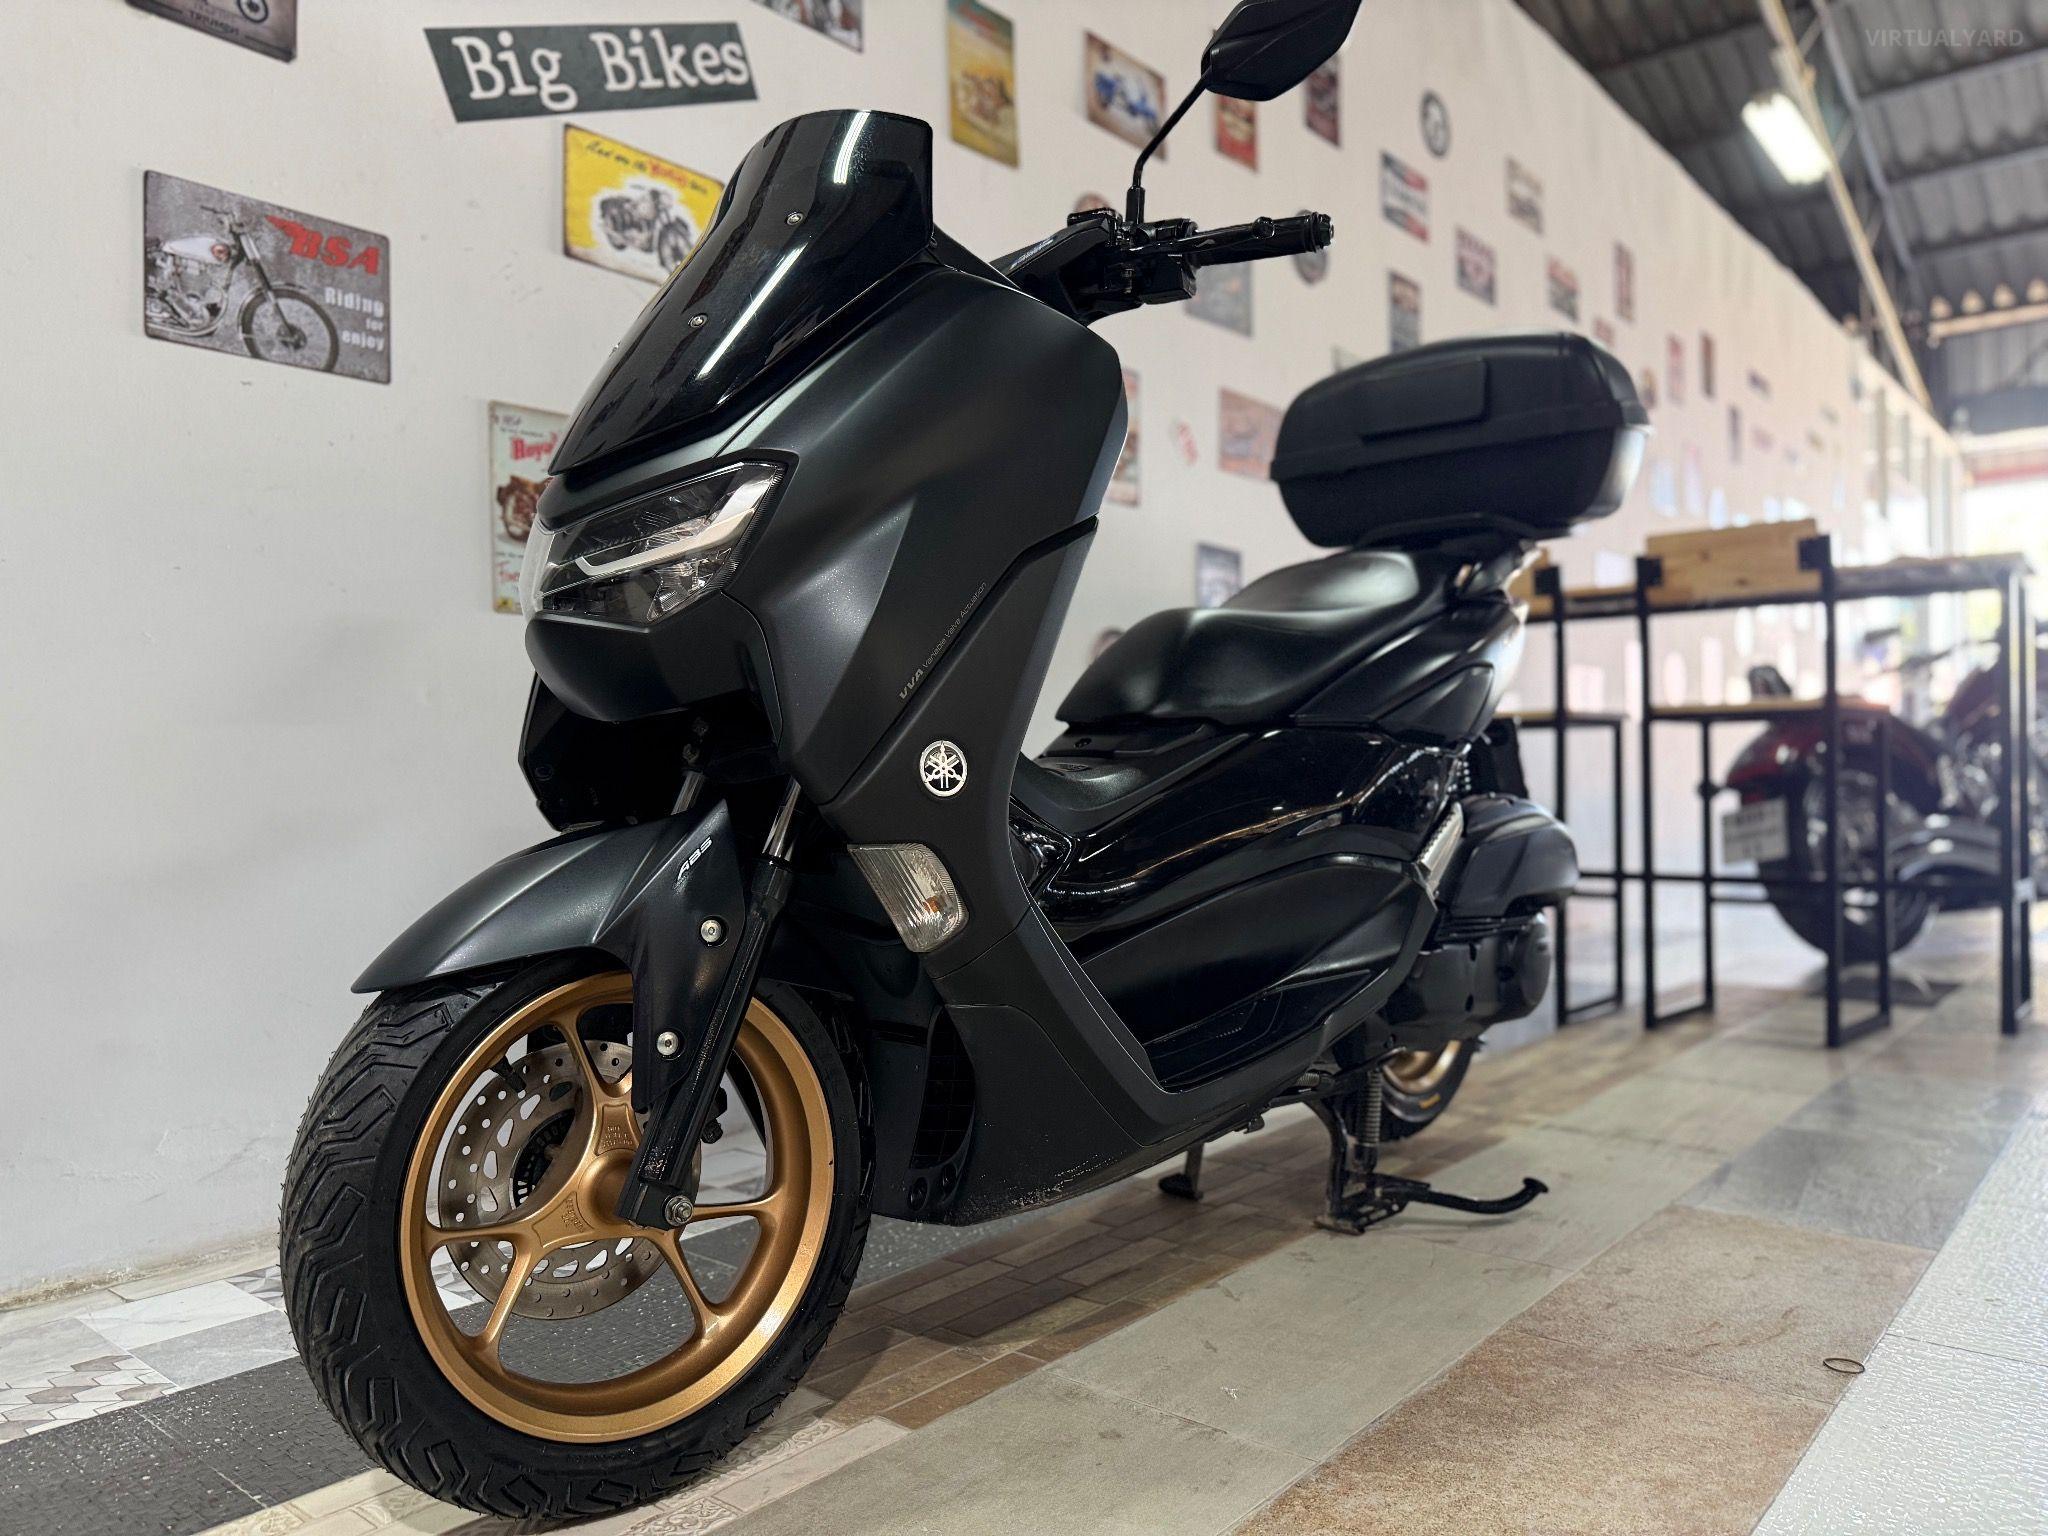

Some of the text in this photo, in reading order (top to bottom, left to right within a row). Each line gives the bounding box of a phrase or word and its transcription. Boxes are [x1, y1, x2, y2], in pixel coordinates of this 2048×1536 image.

[451, 28, 750, 111] Big Bikes
[289, 224, 381, 276] BSA
[325, 287, 385, 318] Riding
[342, 330, 385, 351] enjoy
[900, 668, 924, 699] VVA
[945, 617, 961, 638] Valve
[960, 582, 987, 618] Actuation
[677, 836, 713, 881] ABS
